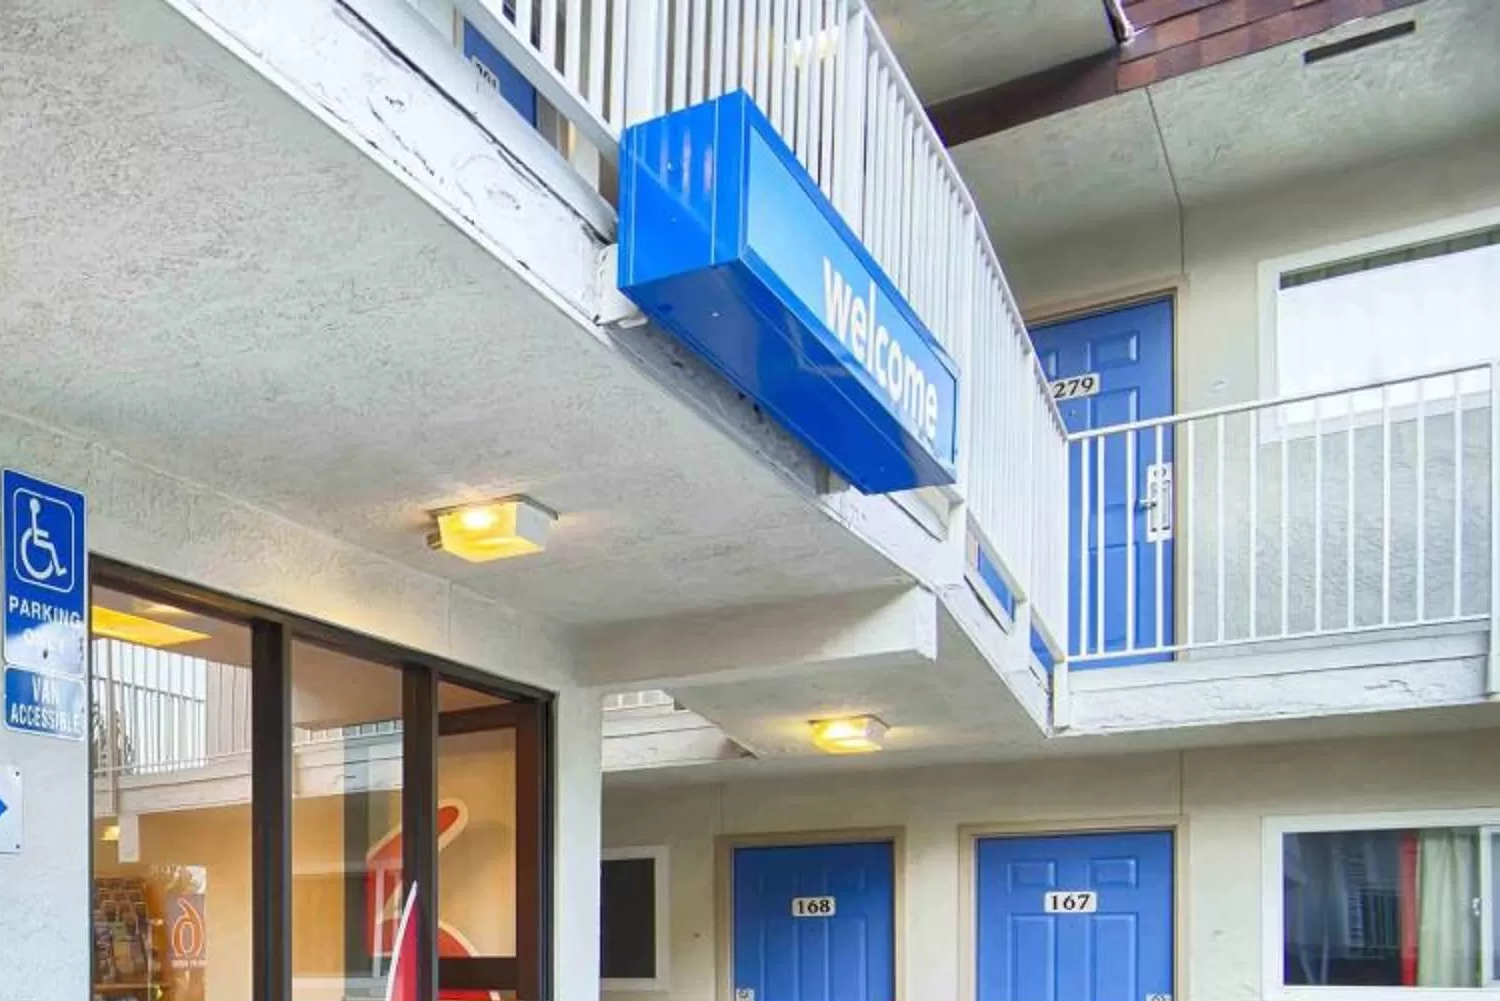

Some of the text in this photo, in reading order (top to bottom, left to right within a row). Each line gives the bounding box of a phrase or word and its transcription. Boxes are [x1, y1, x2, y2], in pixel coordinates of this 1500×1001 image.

[823, 256, 938, 440] welcome
[1053, 377, 1094, 399] 279
[8, 595, 82, 626] PARKING
[31, 674, 61, 705] VAN
[10, 703, 82, 734] ACCESSIBLE
[797, 899, 831, 915] 168
[1052, 893, 1091, 911] 167
